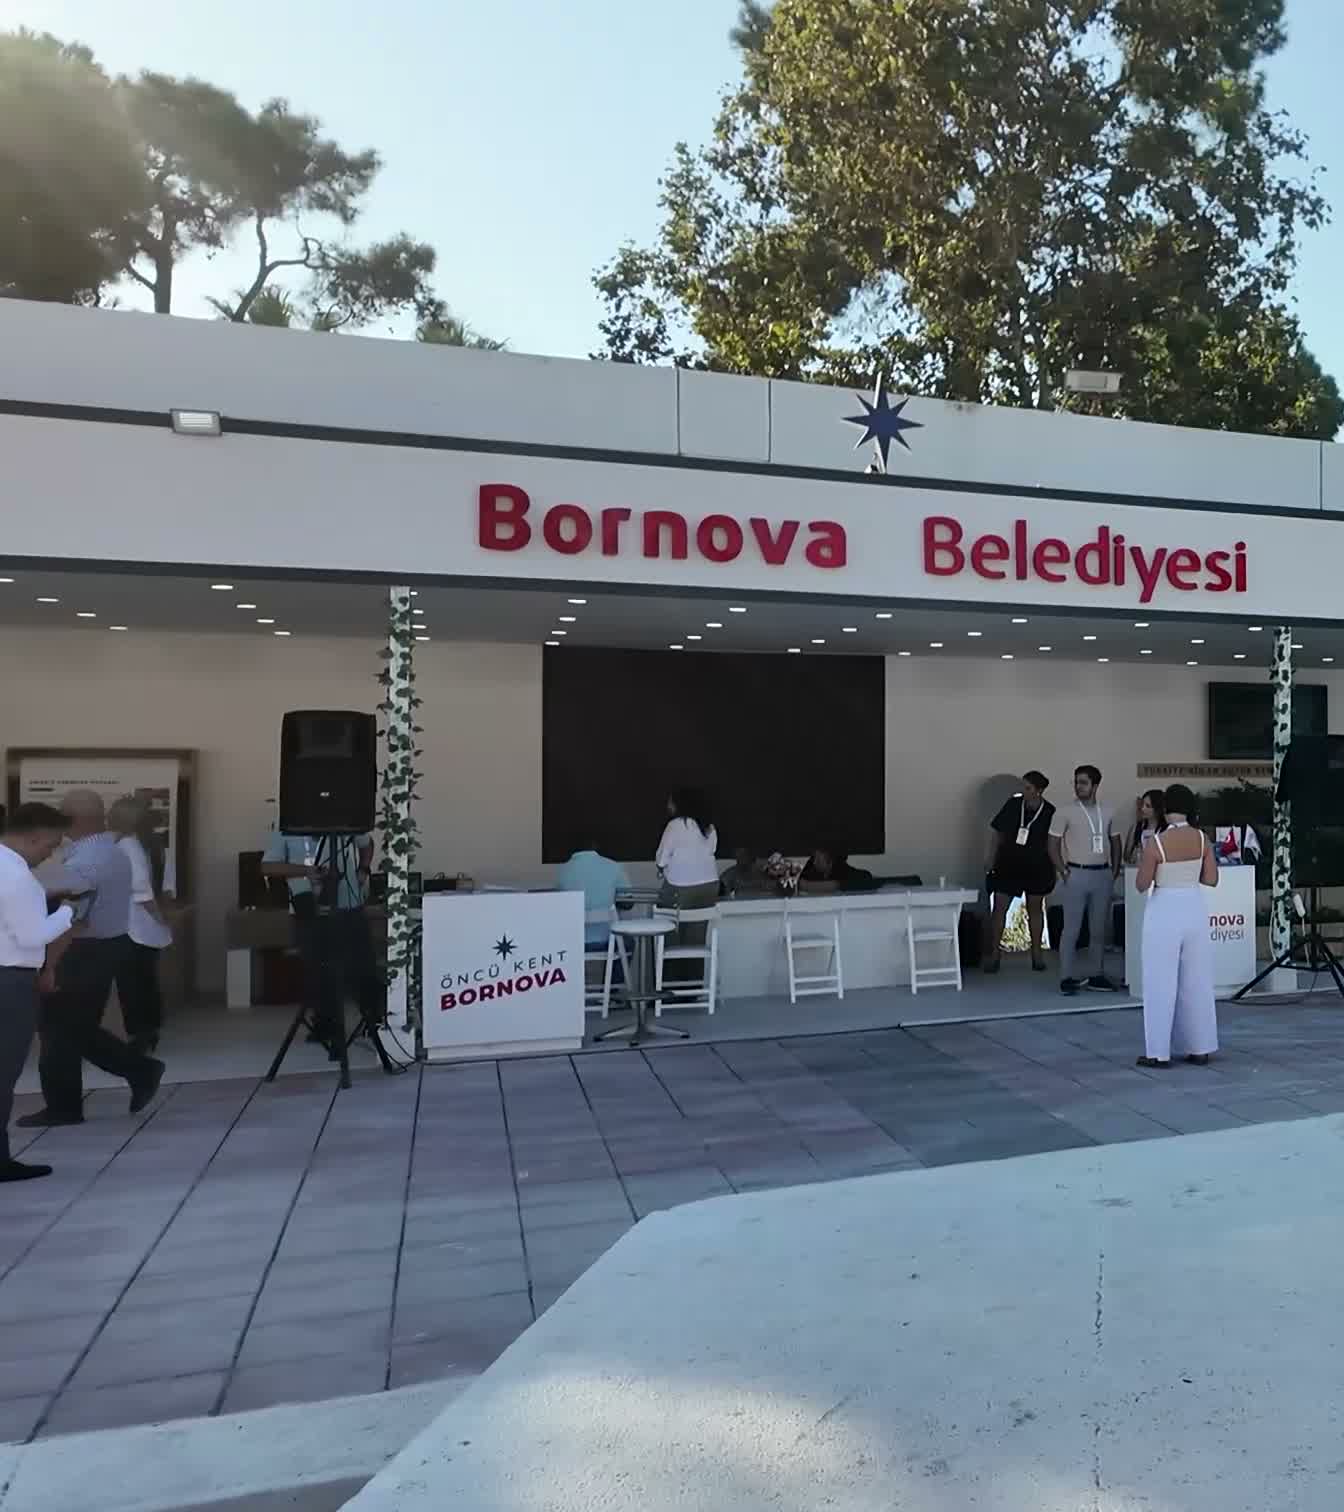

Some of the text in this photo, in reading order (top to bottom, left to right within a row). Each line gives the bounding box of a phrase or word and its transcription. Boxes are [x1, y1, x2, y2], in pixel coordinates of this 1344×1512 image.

[478, 484, 1248, 603] Bornova Belediyesi
[1209, 914, 1245, 927] nova
[1210, 928, 1245, 944] diyesi
[440, 950, 568, 990] ÖNCÜ KENT
[440, 967, 566, 1011] BORNOVA
